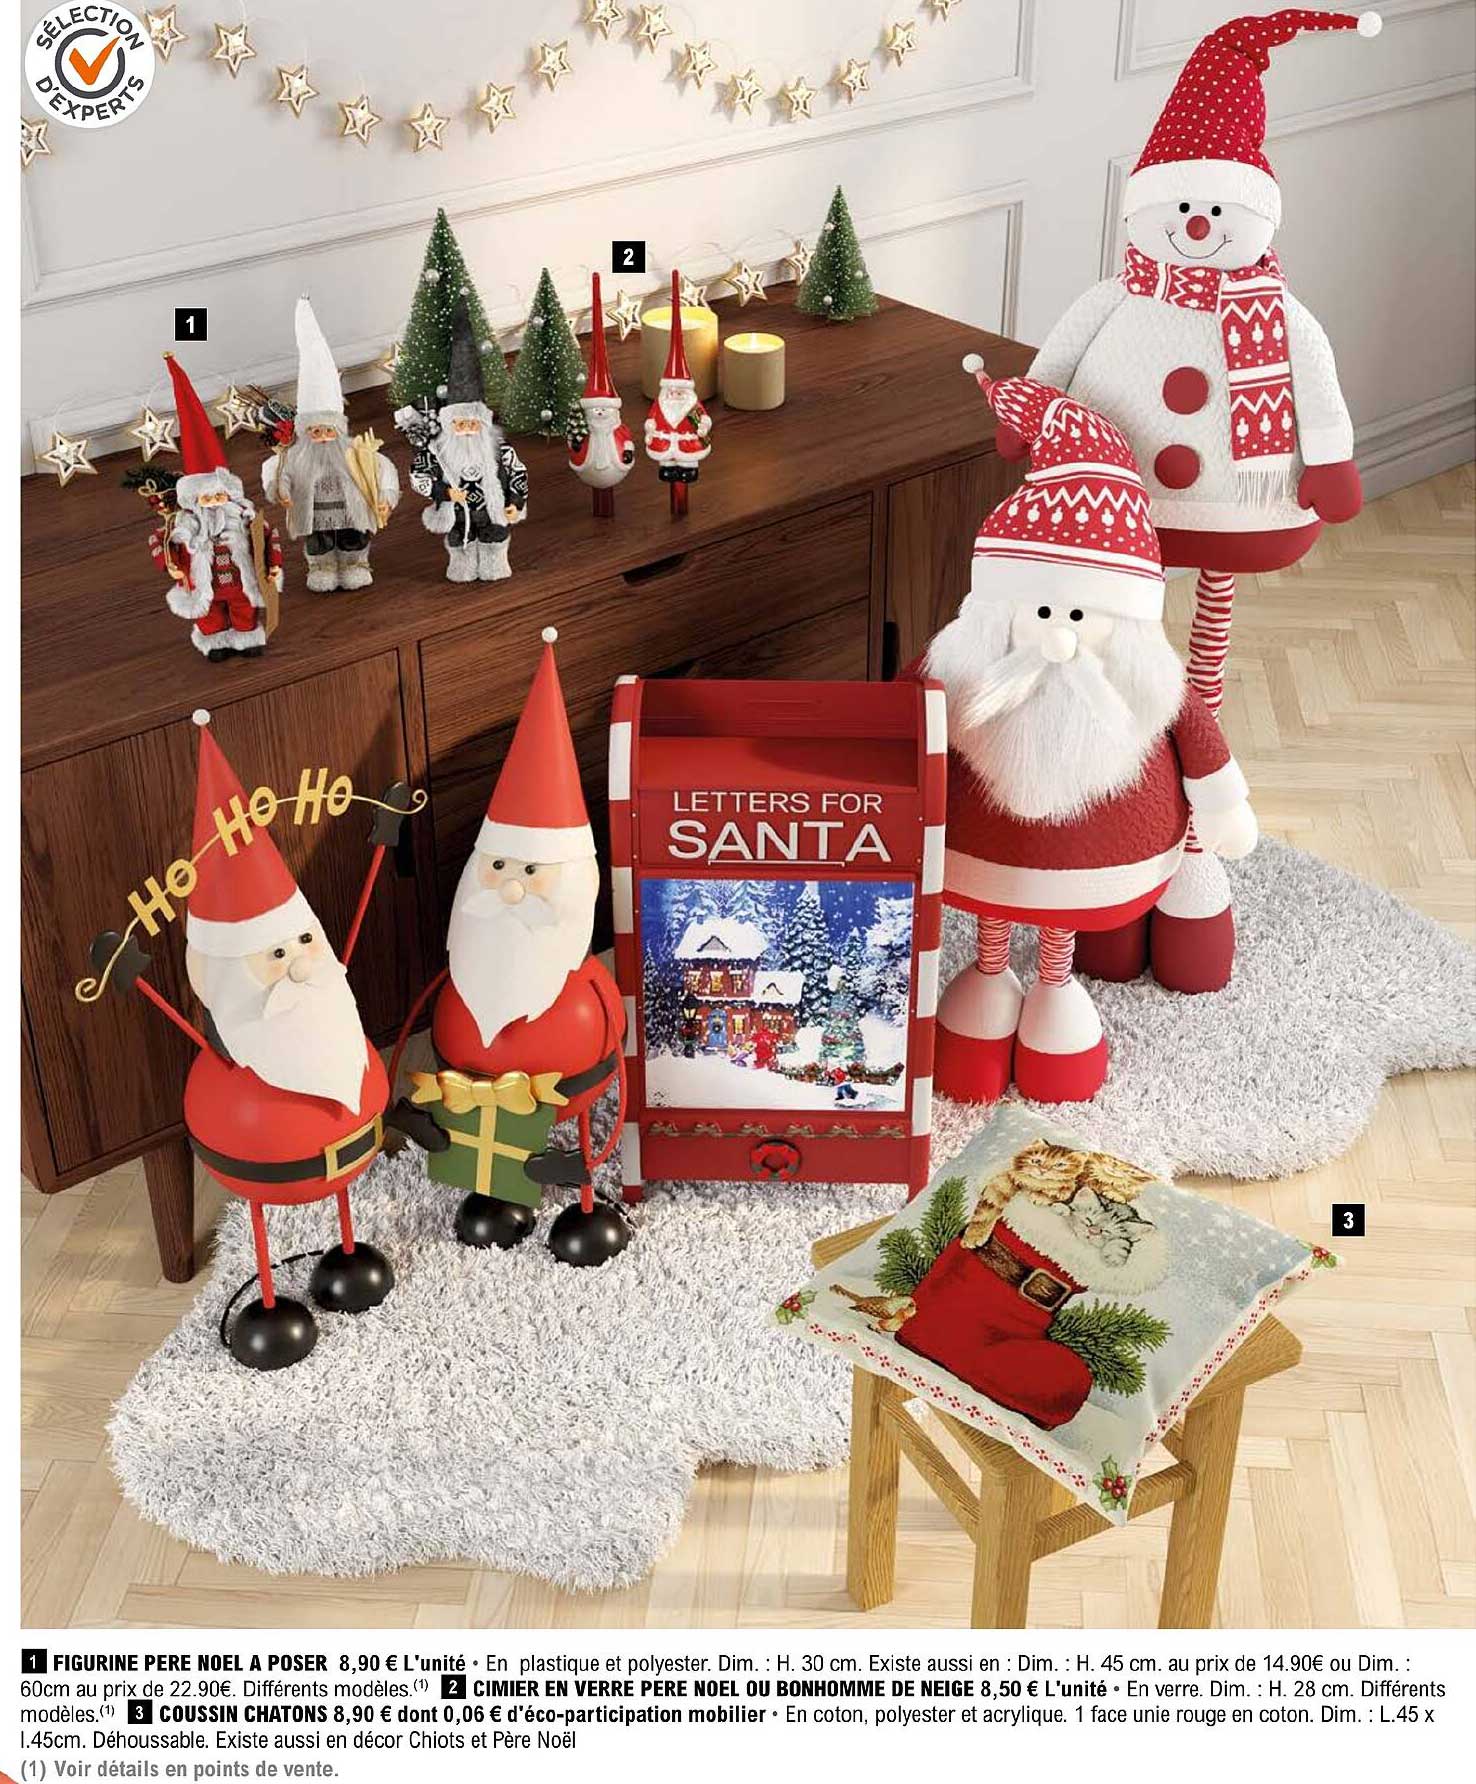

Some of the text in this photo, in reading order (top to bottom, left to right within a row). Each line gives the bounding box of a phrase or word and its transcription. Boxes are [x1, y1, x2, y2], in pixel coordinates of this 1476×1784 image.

[673, 790, 884, 815] LETTERS FOR
[128, 767, 353, 937] HO HO HO
[667, 818, 893, 864] SANTA
